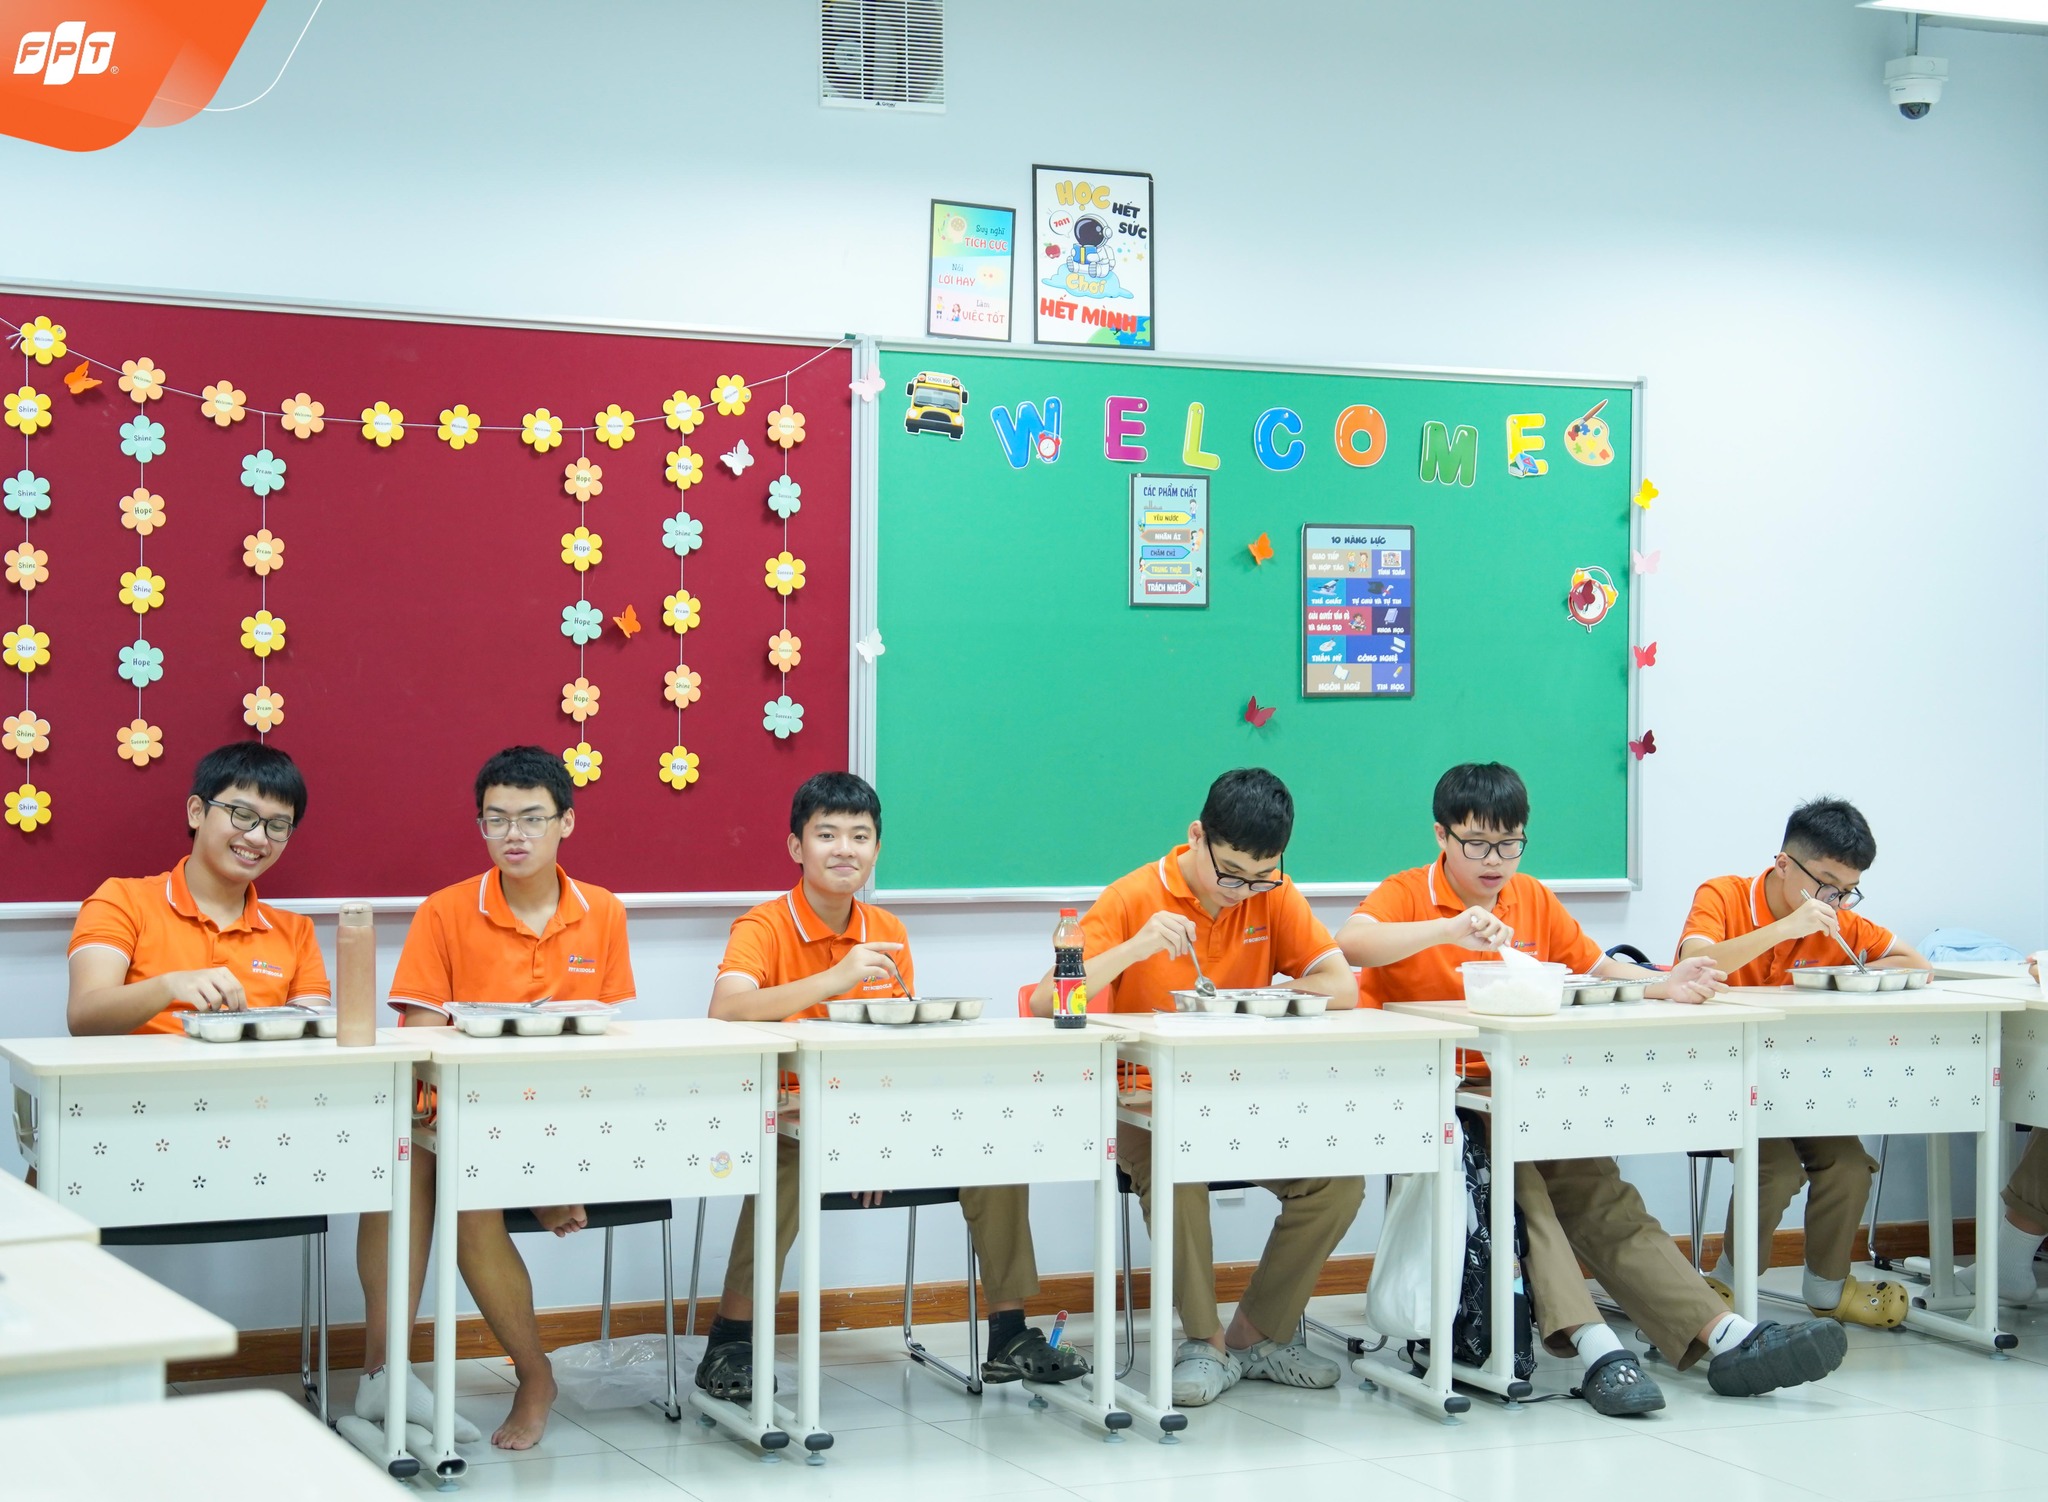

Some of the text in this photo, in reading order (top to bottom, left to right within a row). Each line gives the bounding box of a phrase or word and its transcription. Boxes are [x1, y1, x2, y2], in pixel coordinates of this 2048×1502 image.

[1055, 180, 1110, 211] HỌC
[1112, 201, 1140, 218] HẾT
[976, 225, 1005, 236] Suy nghĩ
[1118, 221, 1148, 239] SỨC
[956, 277, 976, 286] HAY
[1066, 273, 1107, 294] Chơi
[1040, 294, 1137, 333] HẾT MÌNH
[724, 390, 738, 399] Welcome
[990, 396, 1549, 488] WELCOME
[678, 463, 692, 471] Hope
[576, 475, 591, 483] Hope
[1144, 483, 1198, 498] CÁC PHẨM CHẤT
[135, 507, 152, 515] Hope
[1331, 536, 1341, 544] 10
[1370, 535, 1386, 546] LỰC
[574, 544, 590, 552] Hope
[133, 585, 151, 593] Shine
[1148, 582, 1186, 594] TRÁCH NHIỆM
[574, 617, 590, 626] Hope
[1357, 652, 1378, 662] CÔNG
[133, 658, 150, 667] Hope
[1318, 682, 1340, 690] NGÔN
[574, 695, 588, 703] Hope
[575, 759, 590, 768] Hope
[672, 763, 687, 771] Hope
